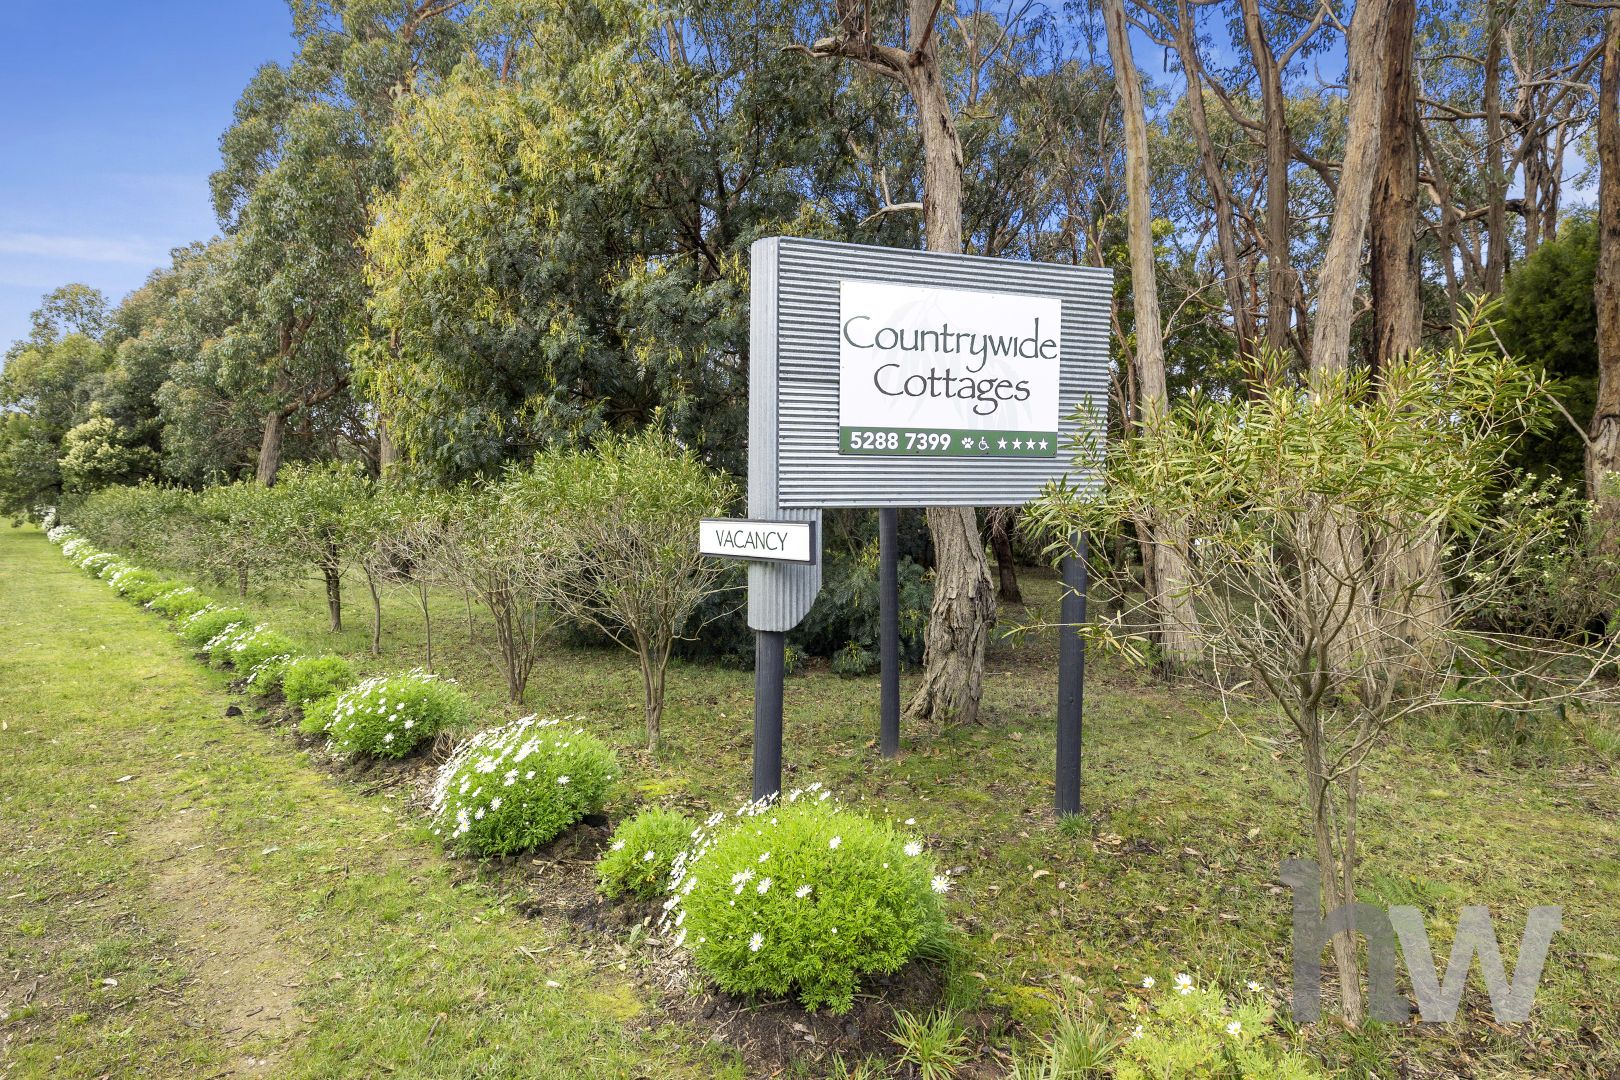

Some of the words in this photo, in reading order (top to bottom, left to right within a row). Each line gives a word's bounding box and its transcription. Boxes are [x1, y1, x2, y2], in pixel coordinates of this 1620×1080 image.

[843, 315, 1058, 373] Countrywide
[873, 363, 1031, 416] Cottages
[850, 431, 899, 450] 5288
[905, 433, 951, 451] 7399
[716, 530, 788, 552] VACANCY
